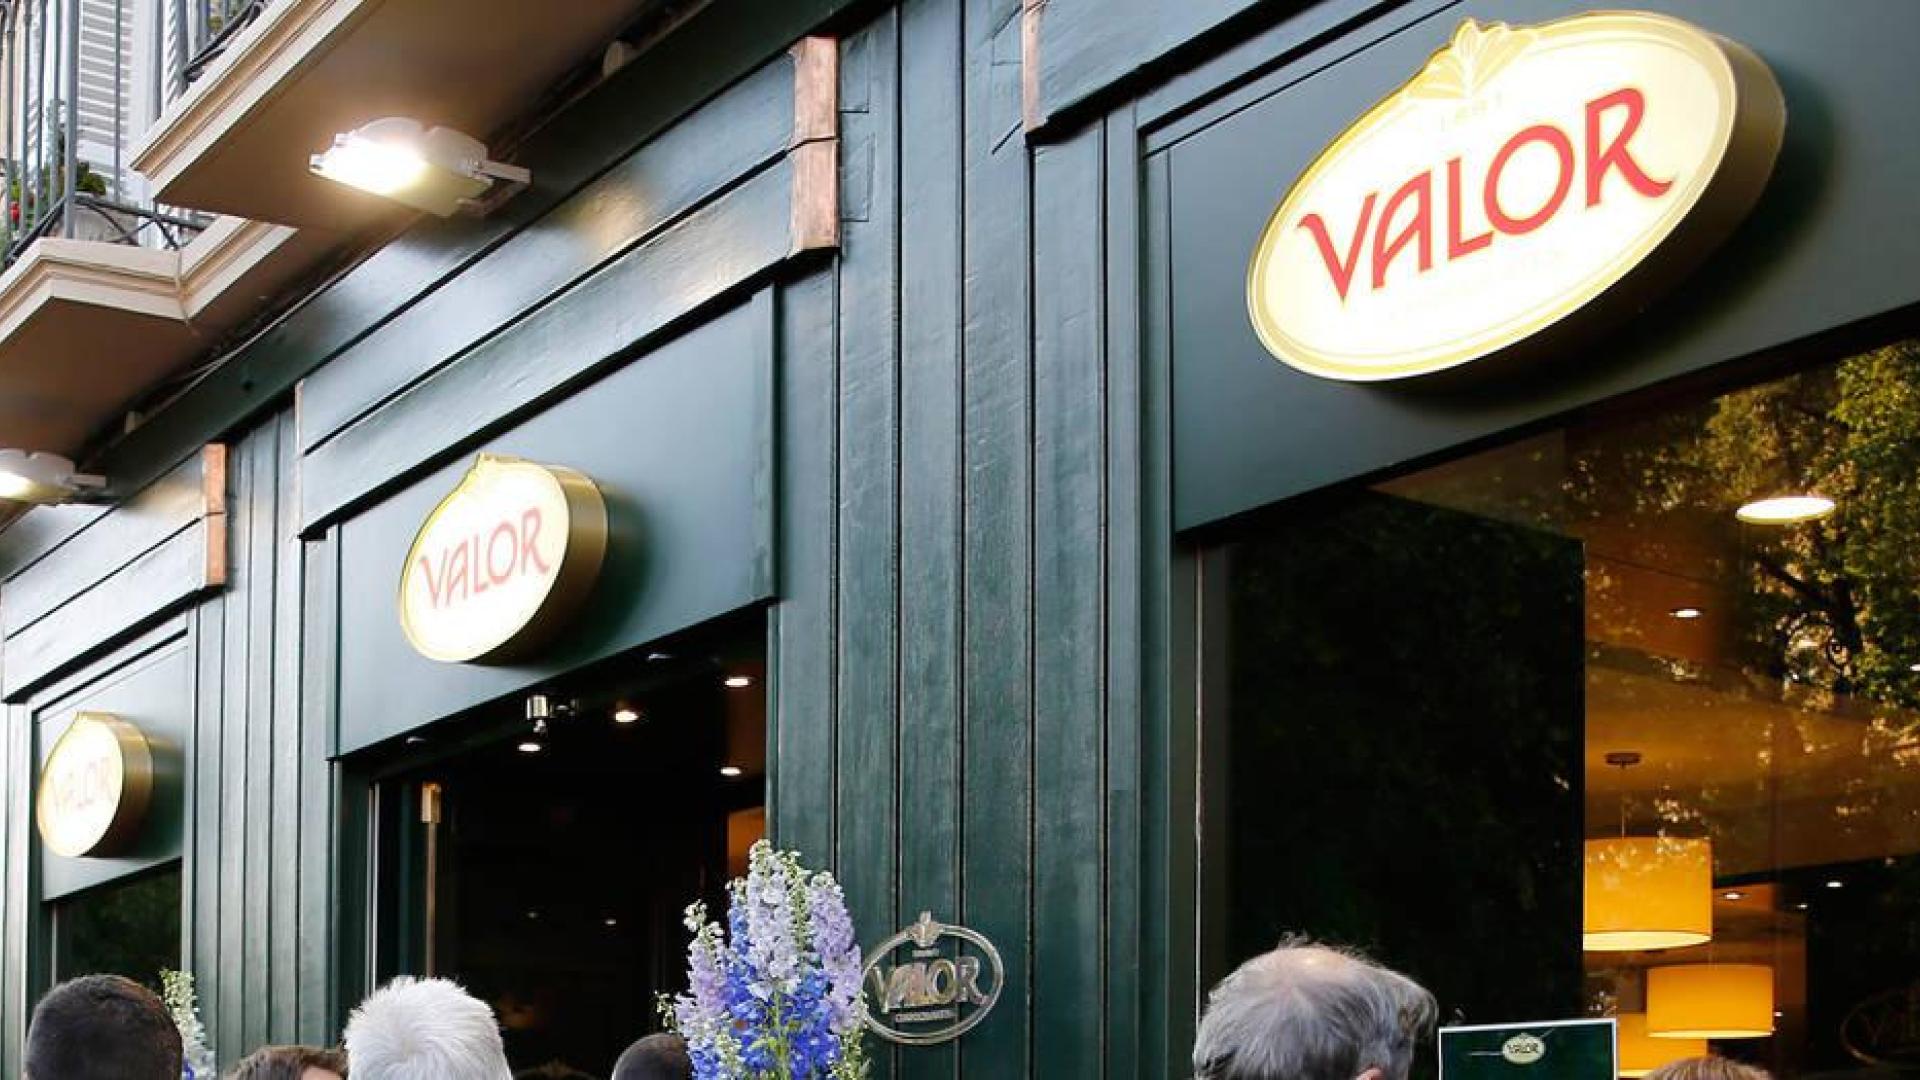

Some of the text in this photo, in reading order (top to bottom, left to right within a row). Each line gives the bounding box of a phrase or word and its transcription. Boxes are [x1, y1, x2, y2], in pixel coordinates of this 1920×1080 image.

[1296, 86, 1675, 303] VALOR
[419, 507, 550, 610] VALOR
[871, 956, 994, 1015] VALOR
